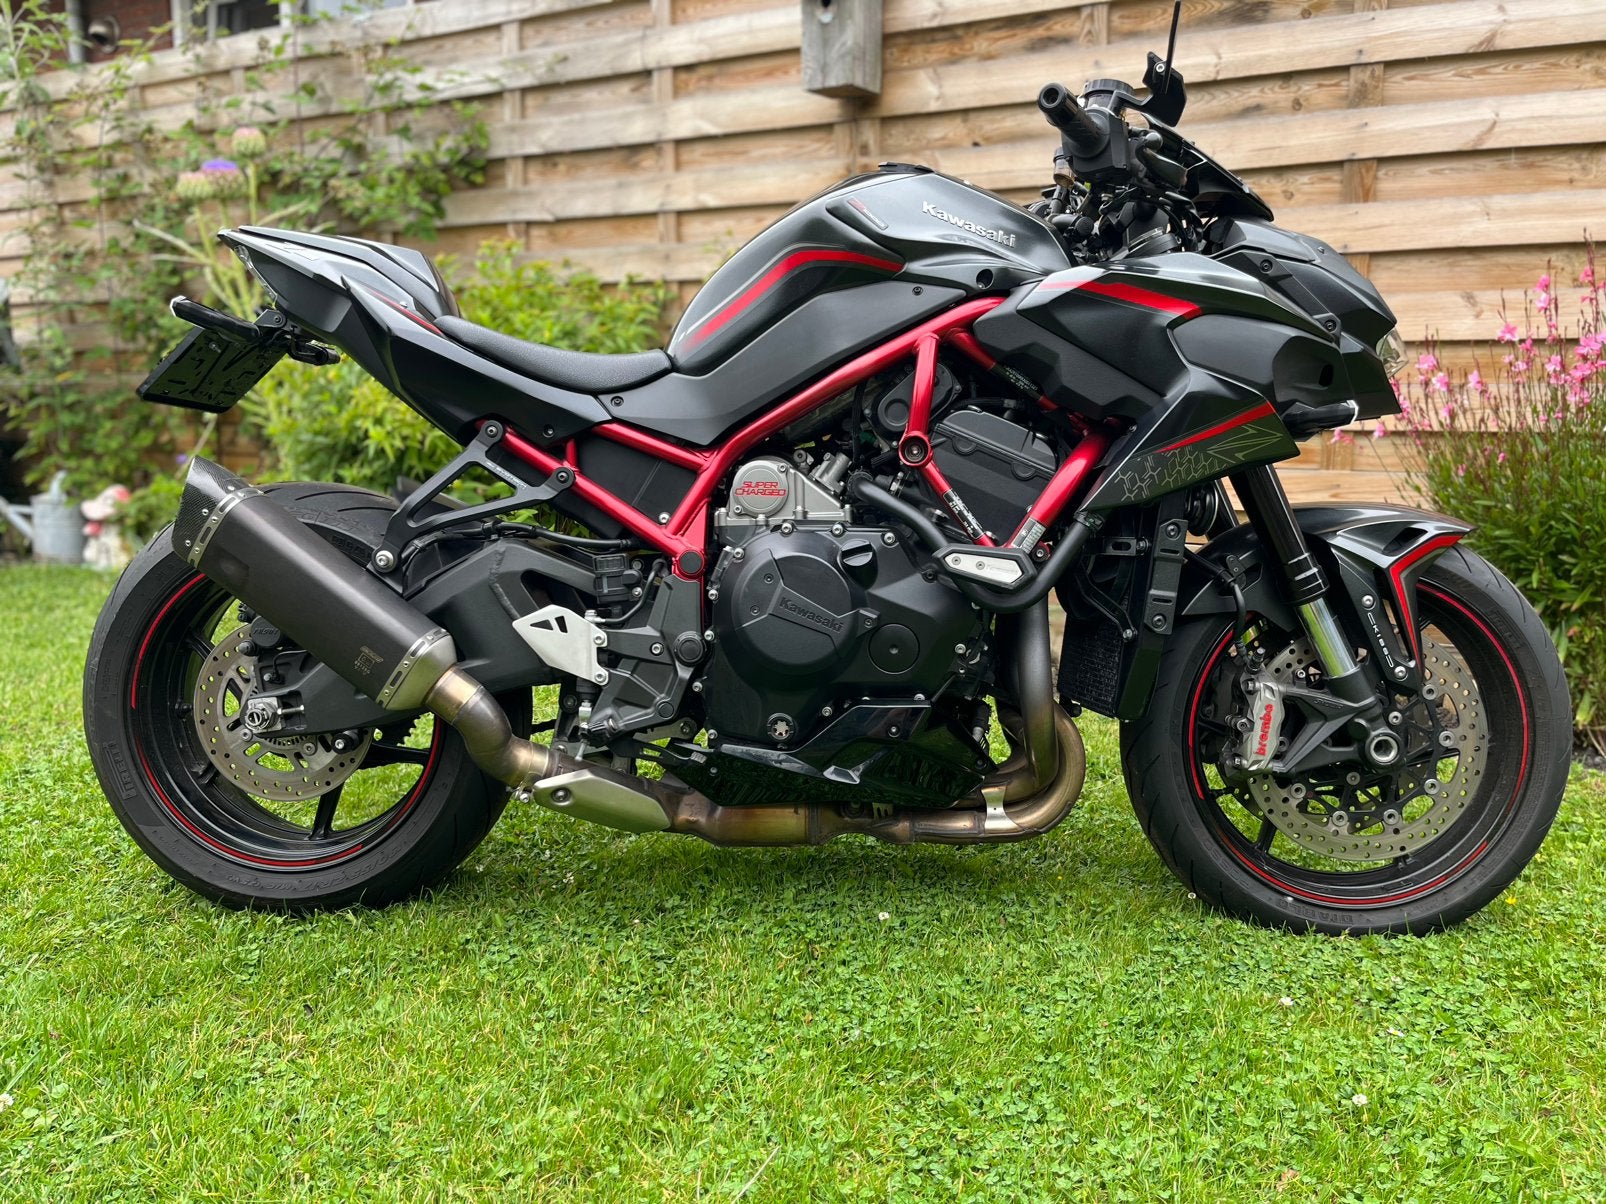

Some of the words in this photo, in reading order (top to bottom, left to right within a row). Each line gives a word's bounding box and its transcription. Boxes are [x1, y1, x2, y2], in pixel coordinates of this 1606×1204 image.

[922, 201, 1016, 248] Kawasaki
[735, 488, 787, 496] CHARGED
[779, 597, 845, 633] Kawasaki
[1254, 703, 1275, 756] brembo
